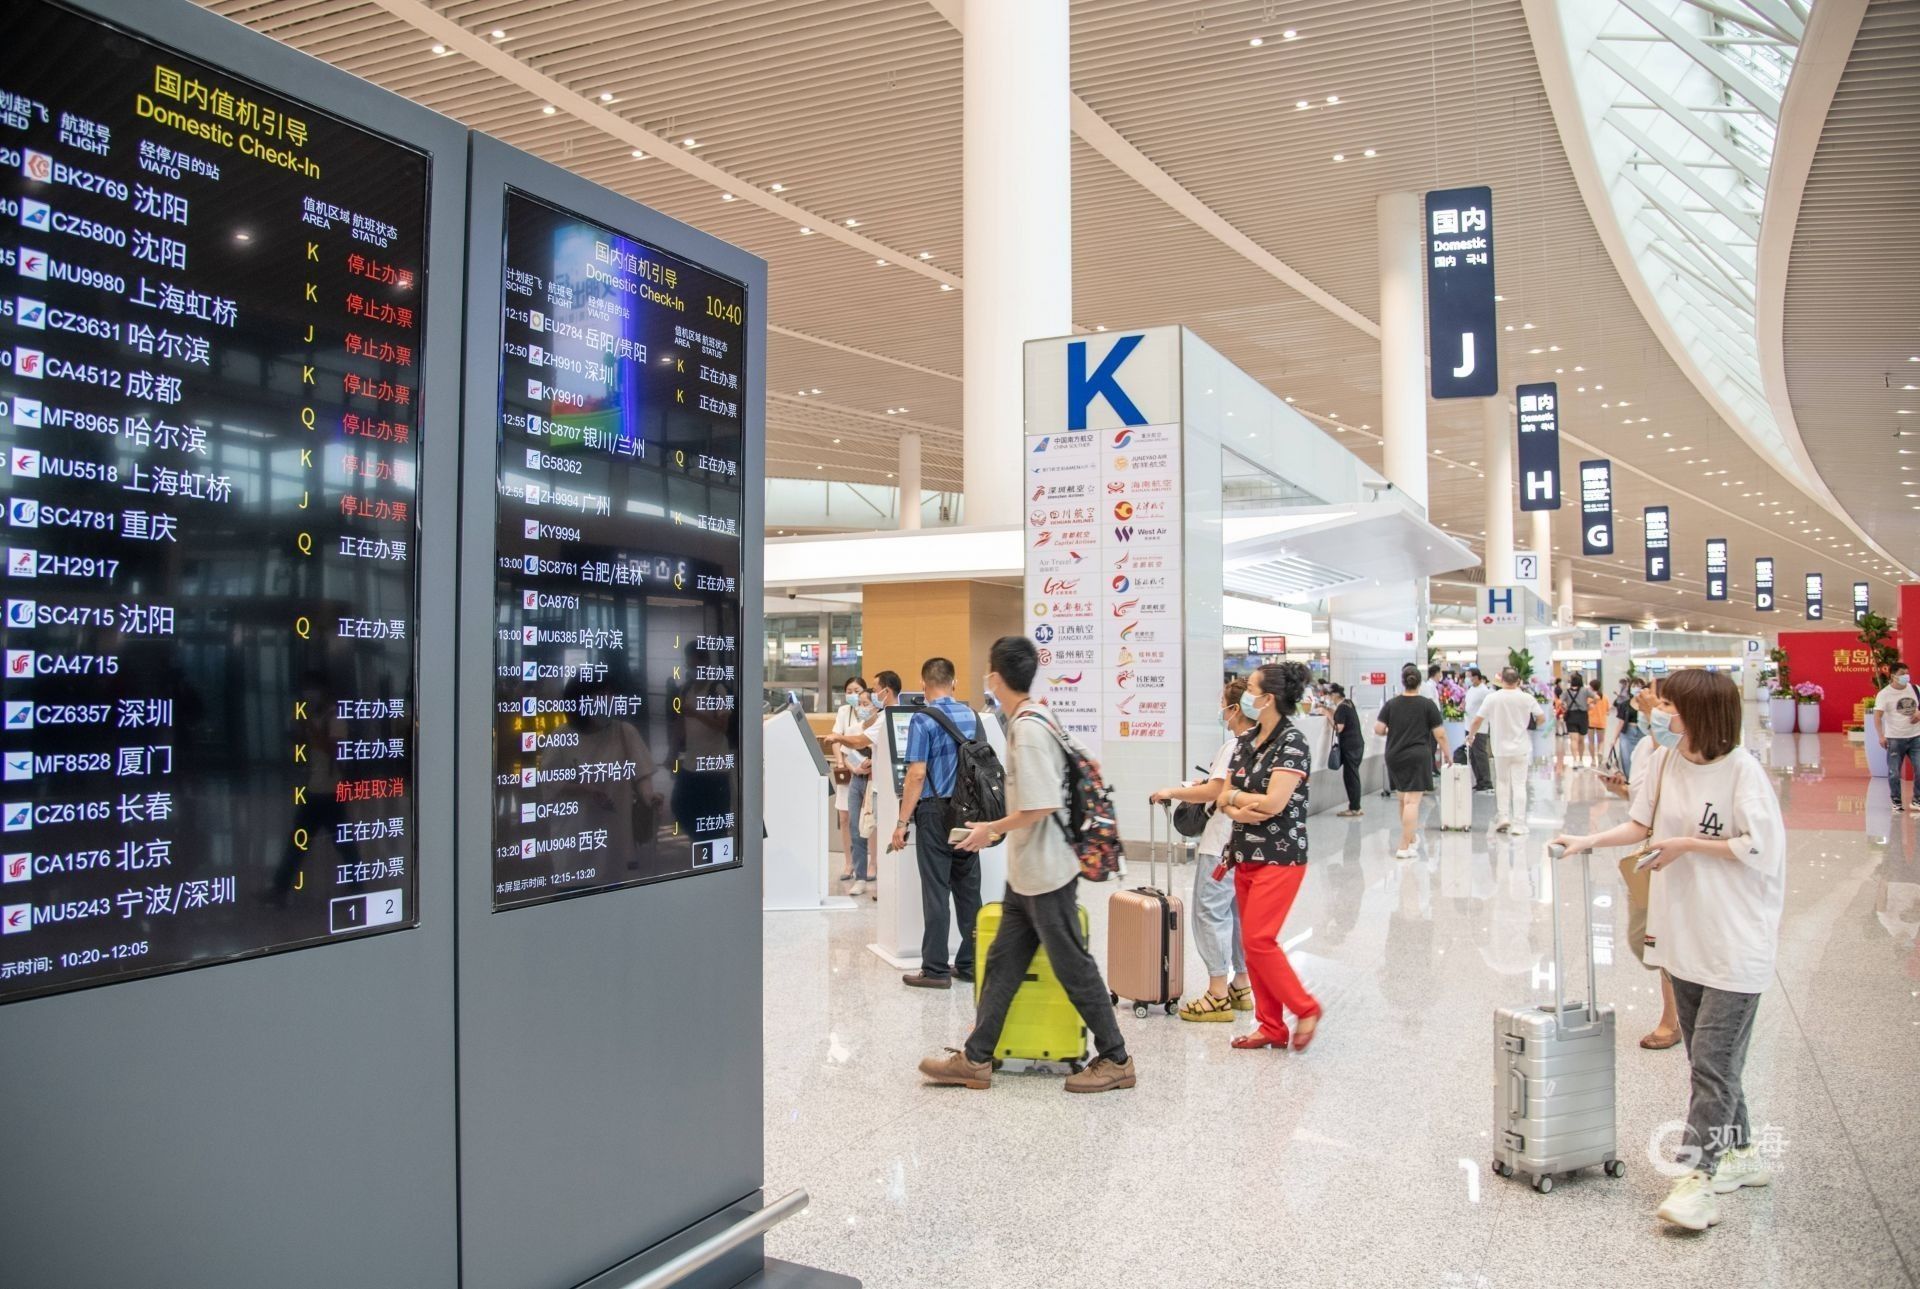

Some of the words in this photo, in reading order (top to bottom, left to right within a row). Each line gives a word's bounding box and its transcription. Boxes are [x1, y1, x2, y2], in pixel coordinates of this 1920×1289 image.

[154, 65, 308, 147] 国内值机引导
[60, 112, 110, 143] 航班号
[136, 94, 234, 147] Domestic
[239, 134, 320, 179] Check-In
[60, 131, 109, 156] FLIGHT
[140, 141, 220, 180] 经停/目的站
[140, 158, 181, 180] VIA/TO
[53, 162, 128, 201] BK2769
[134, 183, 188, 227] 沈阳
[304, 196, 350, 224] 值机区域
[52, 212, 126, 247] CZ5800
[303, 212, 330, 229] AREA
[352, 212, 397, 240] 航班状态
[1433, 206, 1486, 235] 国内
[352, 228, 388, 249] STATUS
[1434, 236, 1487, 252] Domestic
[132, 230, 187, 270] 沈阳
[308, 242, 319, 262] K
[595, 241, 677, 289] 国内值机引导
[49, 260, 125, 294] MU9980
[506, 267, 542, 289] 计划起飞
[586, 264, 637, 294] Domestic
[639, 283, 685, 312] Check-In
[506, 281, 533, 297] SCHED
[130, 277, 238, 328] 上海虹桥
[346, 293, 412, 328] 停止办票
[706, 295, 741, 325] 10:40
[47, 309, 120, 341] CZ3631
[505, 307, 528, 323] 12:15
[304, 325, 313, 342] J
[544, 318, 583, 341] EU2784
[675, 325, 701, 342] 值机区域
[128, 322, 210, 366] 哈尔滨
[505, 342, 527, 358] 12:50
[585, 328, 647, 364] 岳阳/贵阳
[674, 337, 690, 349] AREA
[702, 335, 728, 352] 航班状态
[702, 346, 723, 359] STATUS
[543, 352, 582, 373] ZH9910
[677, 359, 684, 373] K
[1453, 333, 1474, 378] J
[46, 359, 121, 389] CA4512
[584, 359, 613, 386] 深圳
[700, 365, 738, 390] 正在办票
[1067, 334, 1149, 431] K
[126, 370, 181, 404] 成都
[542, 385, 583, 408] KY9910
[1520, 394, 1553, 412] 国内
[44, 407, 119, 434] MF8965
[302, 408, 315, 429] Q
[502, 413, 526, 427] 12:55
[125, 417, 207, 455] 哈尔滨
[541, 421, 580, 440] SC8707
[1054, 434, 1093, 445] 中国南方航空
[583, 427, 645, 459] 银川/兰州
[42, 456, 117, 482] MU5518
[541, 455, 582, 475] G58362
[675, 450, 684, 467] Q
[699, 454, 736, 476] 正在办票
[123, 463, 231, 504] 上海虹桥
[1048, 484, 1085, 494] 深圳航空
[1527, 470, 1552, 500] H
[540, 490, 578, 508] ZH9994
[581, 493, 610, 517] 广州
[40, 507, 114, 530] SC4781
[1050, 507, 1095, 520] 四川航空
[121, 510, 177, 542] 重庆
[539, 525, 581, 542] KY9994
[1138, 528, 1155, 536] West
[1587, 525, 1608, 547] G
[298, 533, 311, 555] Q
[340, 535, 407, 561] 正在办票
[38, 556, 118, 578] ZH2917
[499, 557, 523, 570] 13:00
[539, 560, 577, 576] SC8761
[580, 561, 643, 586] 合肥/桂林
[1651, 557, 1664, 576] F
[1711, 580, 1723, 597] E
[538, 594, 579, 610] CA8761
[1489, 588, 1512, 614] H
[1757, 593, 1771, 608] D
[1808, 605, 1820, 617] C
[38, 606, 114, 625] SC4715
[119, 604, 174, 634] 沈阳
[538, 631, 577, 644] MU6385
[579, 628, 623, 650] 哈尔滨
[1058, 624, 1094, 635] 江西航空
[1609, 626, 1621, 641] F
[1055, 649, 1094, 660] 福州航空
[1748, 640, 1759, 652] D
[37, 655, 118, 674] CA4715
[538, 665, 577, 678] CZ6139
[579, 661, 608, 683] 南宁
[36, 705, 110, 724] CZ6357
[118, 699, 173, 728] 深圳
[295, 701, 307, 720] K
[337, 698, 405, 720] 正在办票
[537, 699, 576, 713] SC8033
[578, 694, 642, 718] 杭州/南宁
[1131, 721, 1152, 729] Lucky
[537, 733, 579, 749] CA8033
[35, 754, 110, 774] MF8528
[116, 745, 172, 776] 厦门
[537, 768, 576, 783] MU5589
[578, 760, 636, 784] 齐齐哈尔
[336, 777, 404, 803] 航班取消
[35, 802, 110, 824] CZ6165
[116, 792, 172, 824] 长春
[536, 801, 579, 818] QF4256
[695, 812, 735, 832] 正在办票
[1699, 802, 1724, 837] LA
[537, 837, 576, 854] MU9048
[578, 828, 608, 852] 西安
[723, 844, 729, 856] 2
[34, 850, 110, 874] CA1576
[116, 838, 171, 871] 北京
[496, 845, 520, 858] 13:20
[701, 848, 708, 860] 2
[336, 856, 405, 884] 正在办票
[116, 875, 236, 919] 宁波/深圳
[385, 899, 394, 915] 2
[33, 899, 110, 925] MU5243
[348, 904, 355, 921] 1
